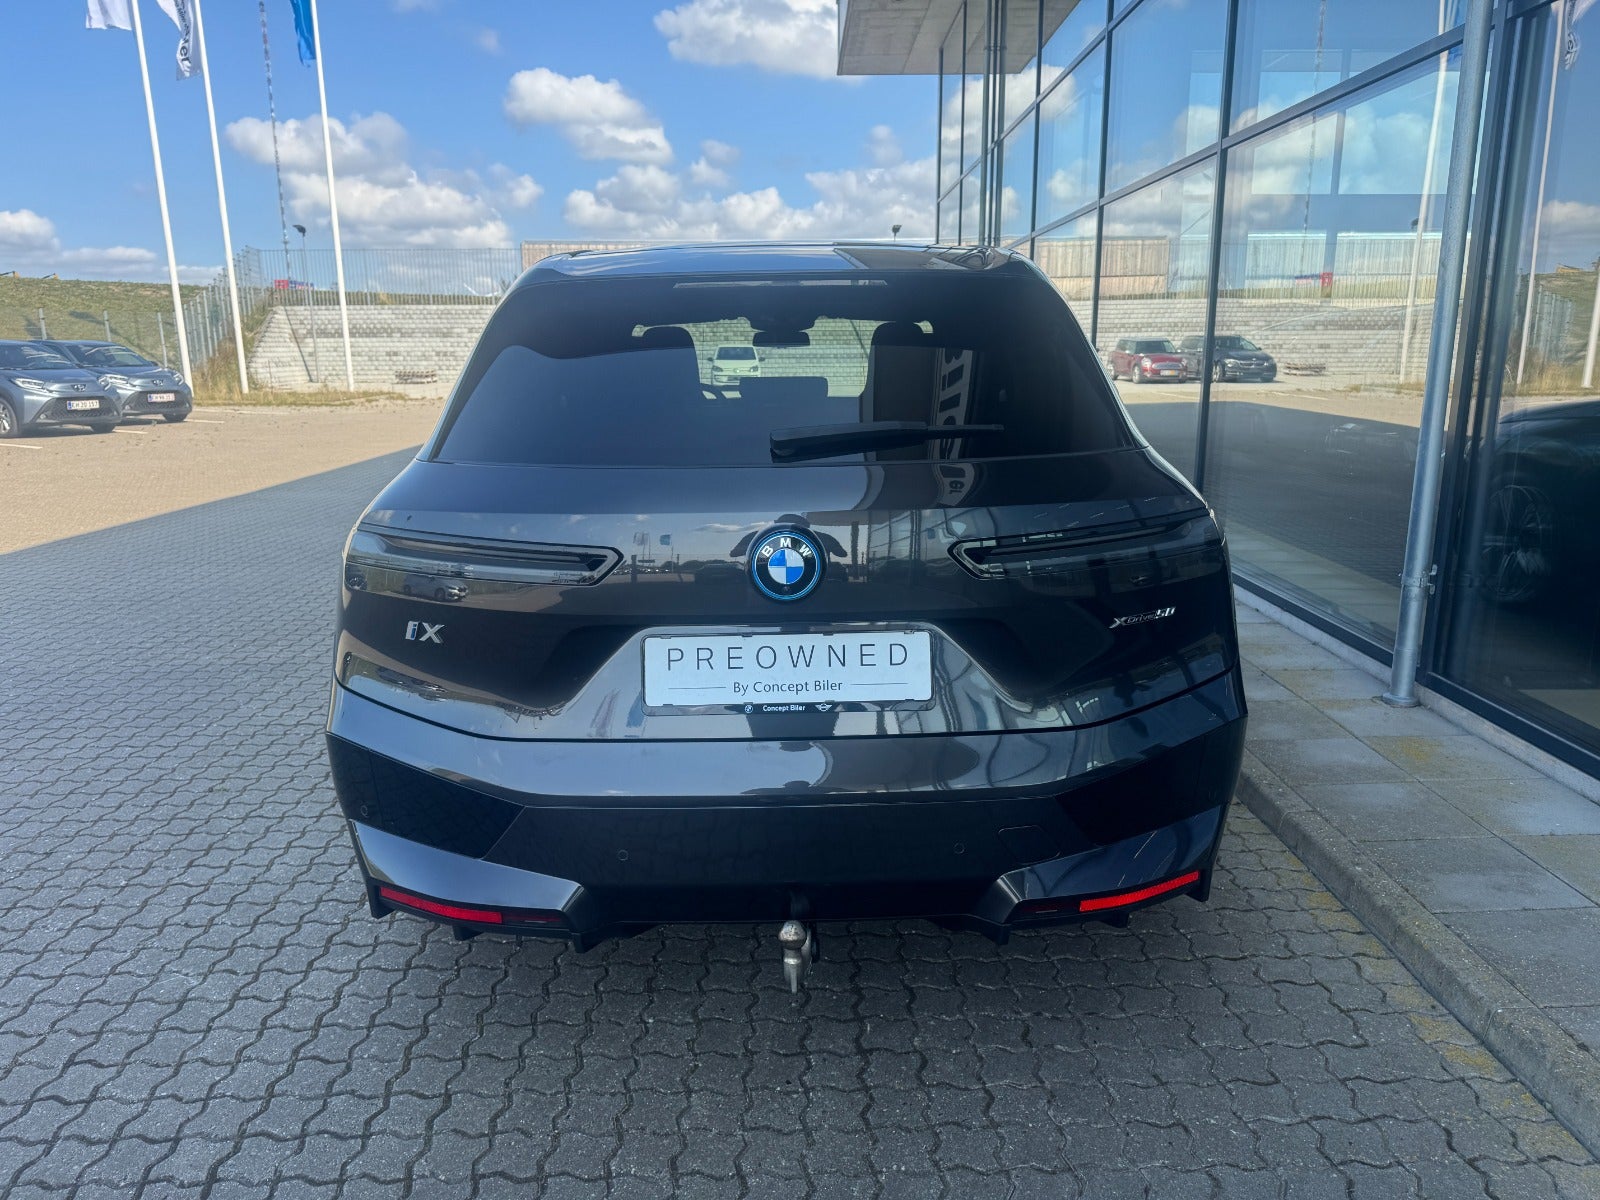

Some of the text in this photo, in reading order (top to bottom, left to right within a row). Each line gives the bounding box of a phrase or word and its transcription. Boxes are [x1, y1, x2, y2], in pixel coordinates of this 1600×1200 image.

[760, 536, 812, 558] BMW
[405, 620, 445, 644] iX
[667, 643, 908, 671] PREOWNED
[733, 679, 843, 696] By Concept Biler
[762, 704, 789, 712] Concept
